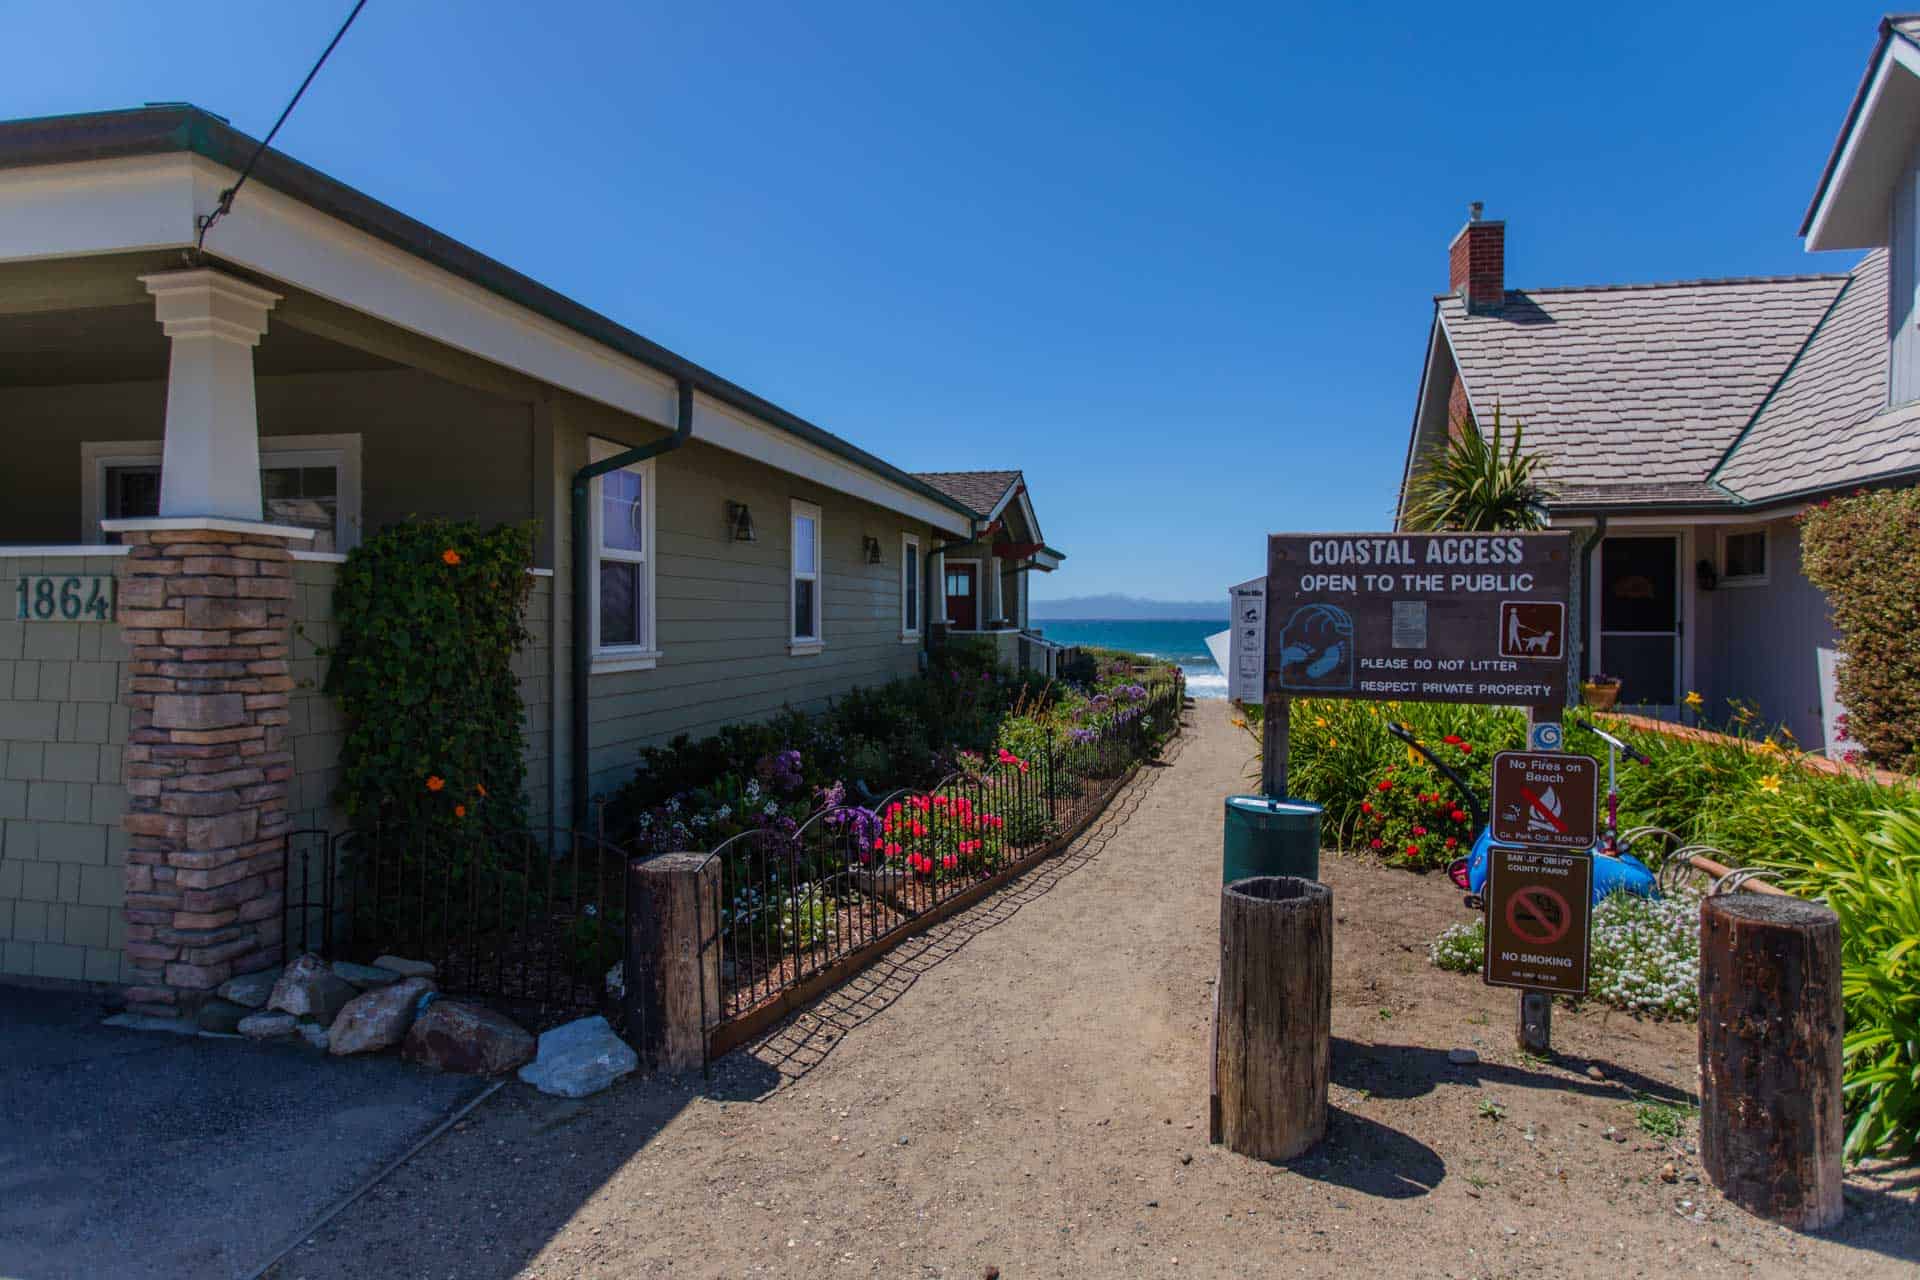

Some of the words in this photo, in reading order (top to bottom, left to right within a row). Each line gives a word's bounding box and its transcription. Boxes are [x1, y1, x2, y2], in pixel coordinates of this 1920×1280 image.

[1309, 539, 1415, 565] COASTAL
[1426, 538, 1524, 564] ACCESS
[1301, 575, 1356, 592] OPEN
[1364, 575, 1394, 592] TO
[1402, 575, 1444, 592] THE
[1452, 575, 1533, 592] PUBLIC
[16, 577, 109, 620] 1864
[1361, 659, 1408, 669] PLEASE
[1414, 660, 1432, 670] DO
[1438, 661, 1465, 671] NOT
[1471, 661, 1517, 671] LITTER
[1361, 681, 1417, 693] RESPECT
[1423, 682, 1473, 694] PRIVATE
[1480, 684, 1551, 696] PROPERTY
[1509, 760, 1526, 769] No
[1532, 761, 1561, 771] Fires
[1566, 764, 1581, 772] on
[1526, 772, 1564, 783] Beach
[1507, 864, 1539, 872] COUNTY
[1502, 952, 1518, 961] NO
[1521, 954, 1572, 967] SMOKING
